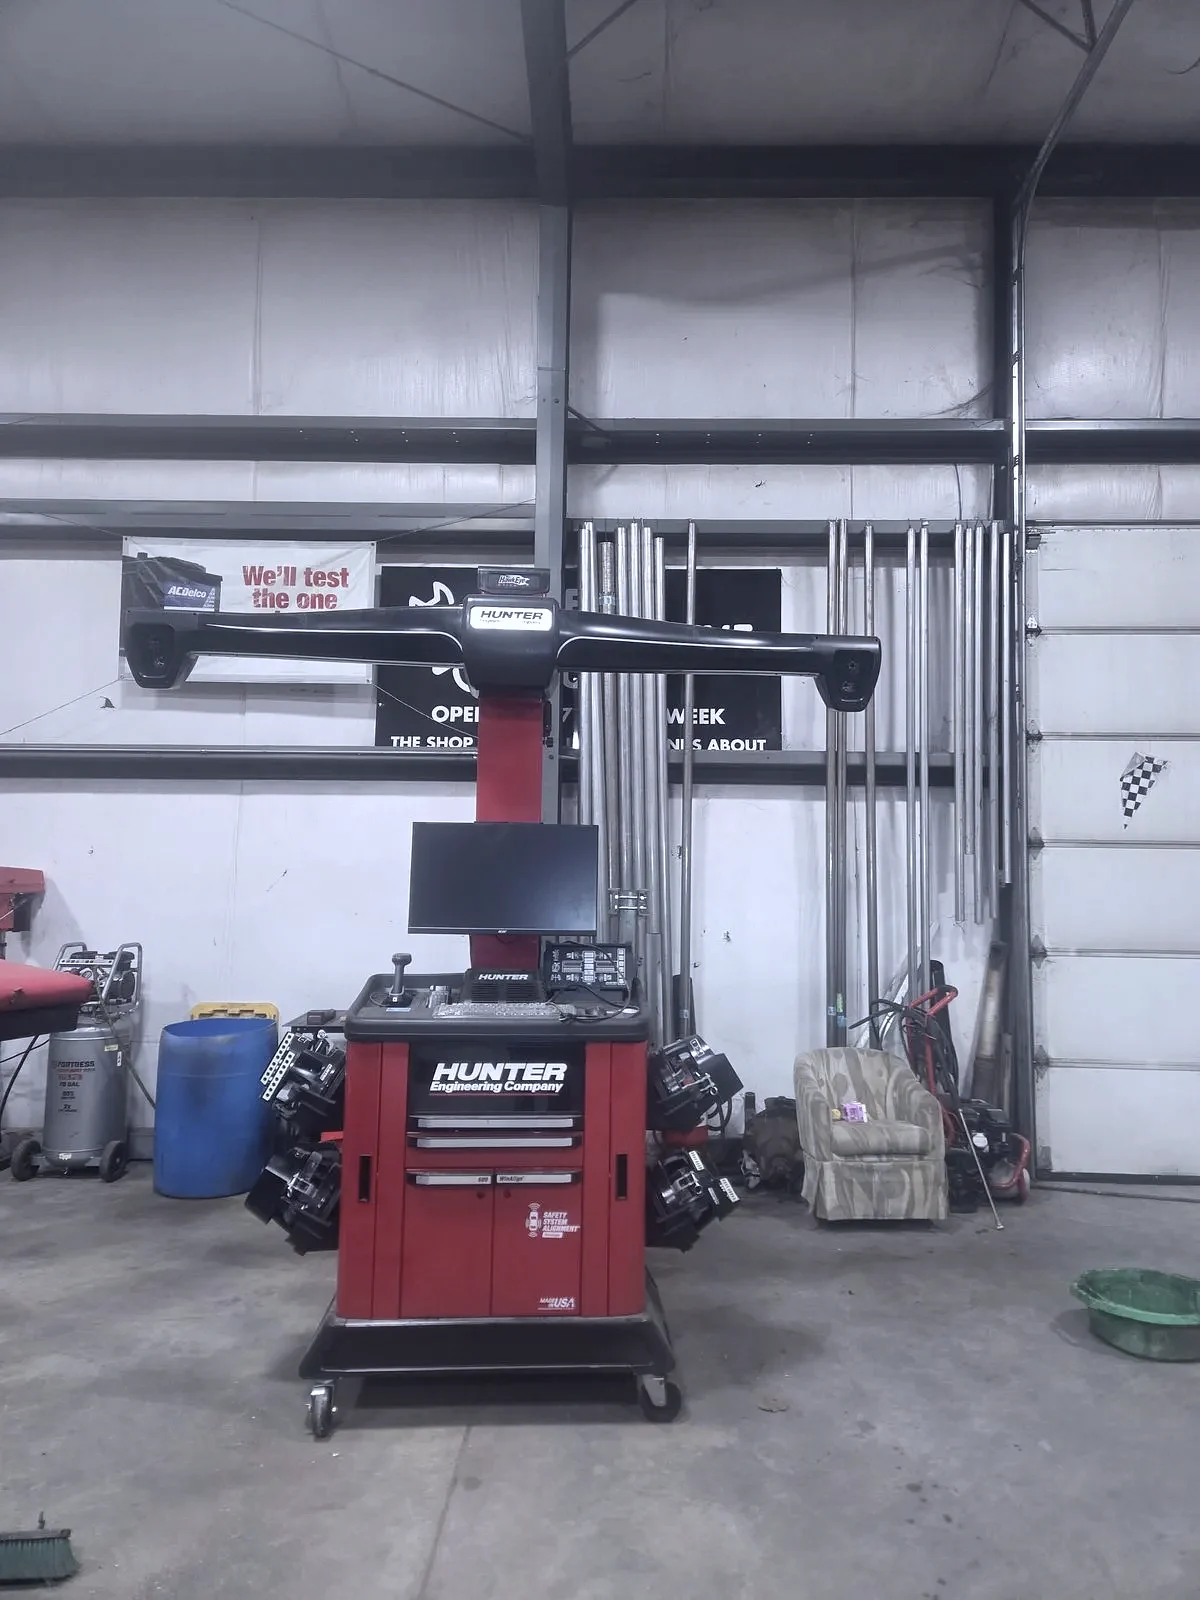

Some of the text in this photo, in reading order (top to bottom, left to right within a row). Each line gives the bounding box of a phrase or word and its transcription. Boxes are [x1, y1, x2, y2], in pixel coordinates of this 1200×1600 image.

[242, 565, 349, 588] We'll test
[167, 585, 207, 599] ACDelco
[252, 588, 338, 610] the one
[480, 610, 544, 620] HUNTER
[390, 735, 474, 748] THE SHOP
[707, 738, 767, 750] ABOUT
[478, 973, 529, 981] HUNTER
[432, 1062, 568, 1081] HUNTER
[429, 1081, 564, 1094] Engineering Company
[543, 1211, 568, 1219] SAFETY
[554, 1297, 575, 1308] USA
